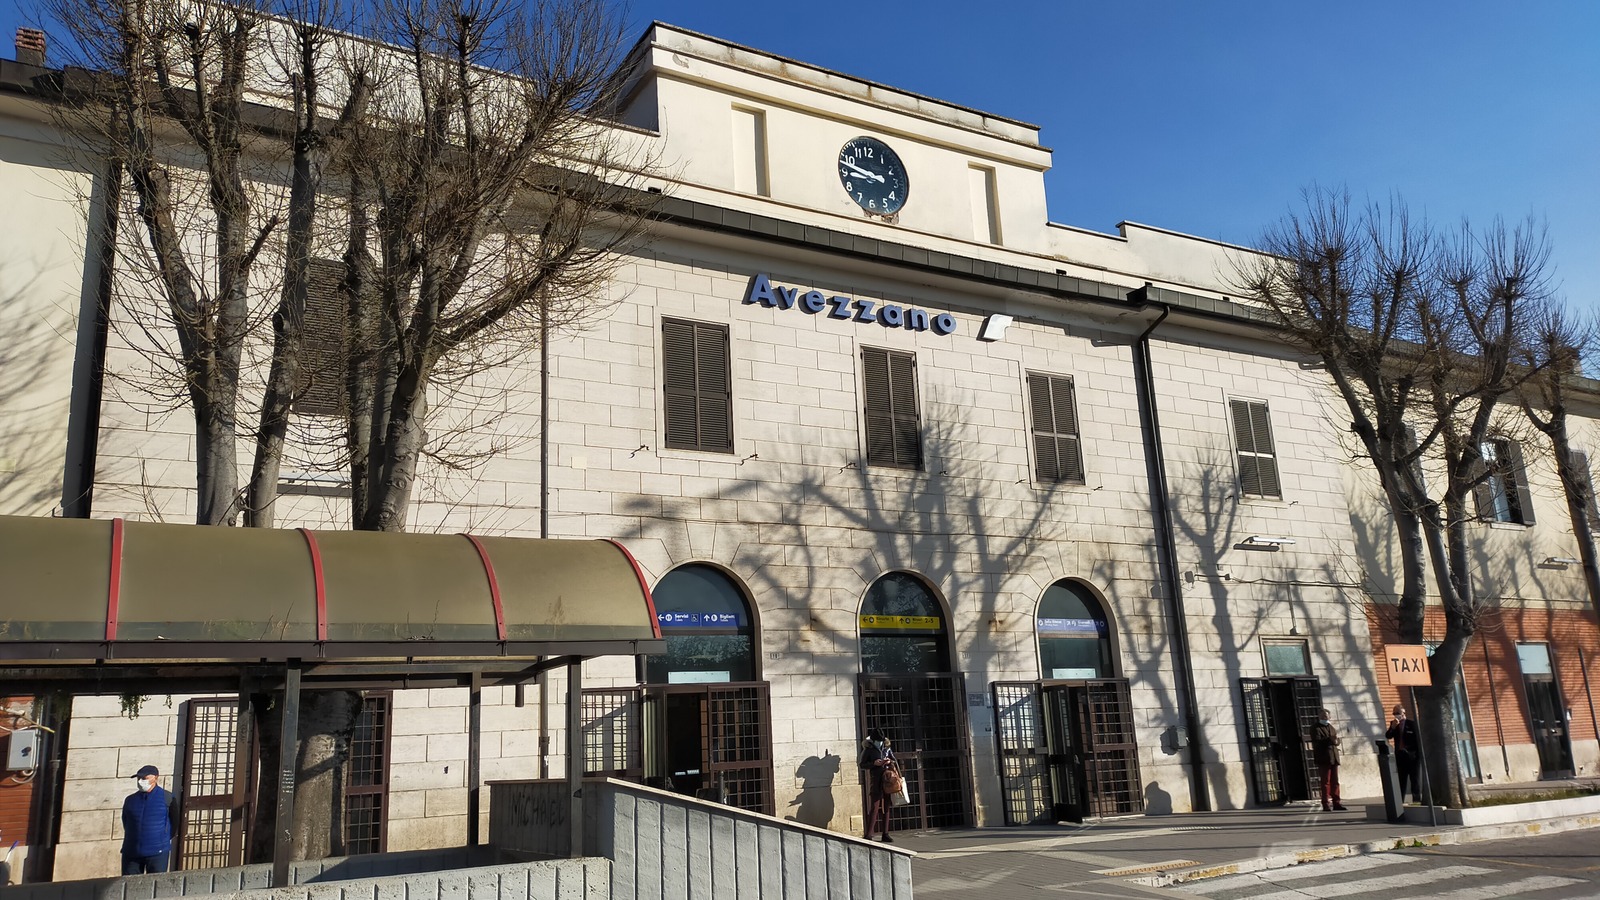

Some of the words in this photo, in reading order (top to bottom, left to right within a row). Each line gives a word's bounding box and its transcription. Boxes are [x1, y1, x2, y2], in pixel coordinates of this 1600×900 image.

[854, 147, 862, 158] 11
[863, 146, 874, 158] 12
[845, 155, 855, 166] 10
[841, 167, 848, 177] 9
[888, 165, 894, 176] 2
[846, 181, 853, 192] 8
[892, 178, 899, 188] 3
[857, 192, 863, 202] 7
[888, 190, 896, 201] 4
[868, 199, 876, 209] 6
[882, 198, 888, 208] 5
[744, 273, 957, 336] Avezzano
[1390, 658, 1425, 672] TAXI
